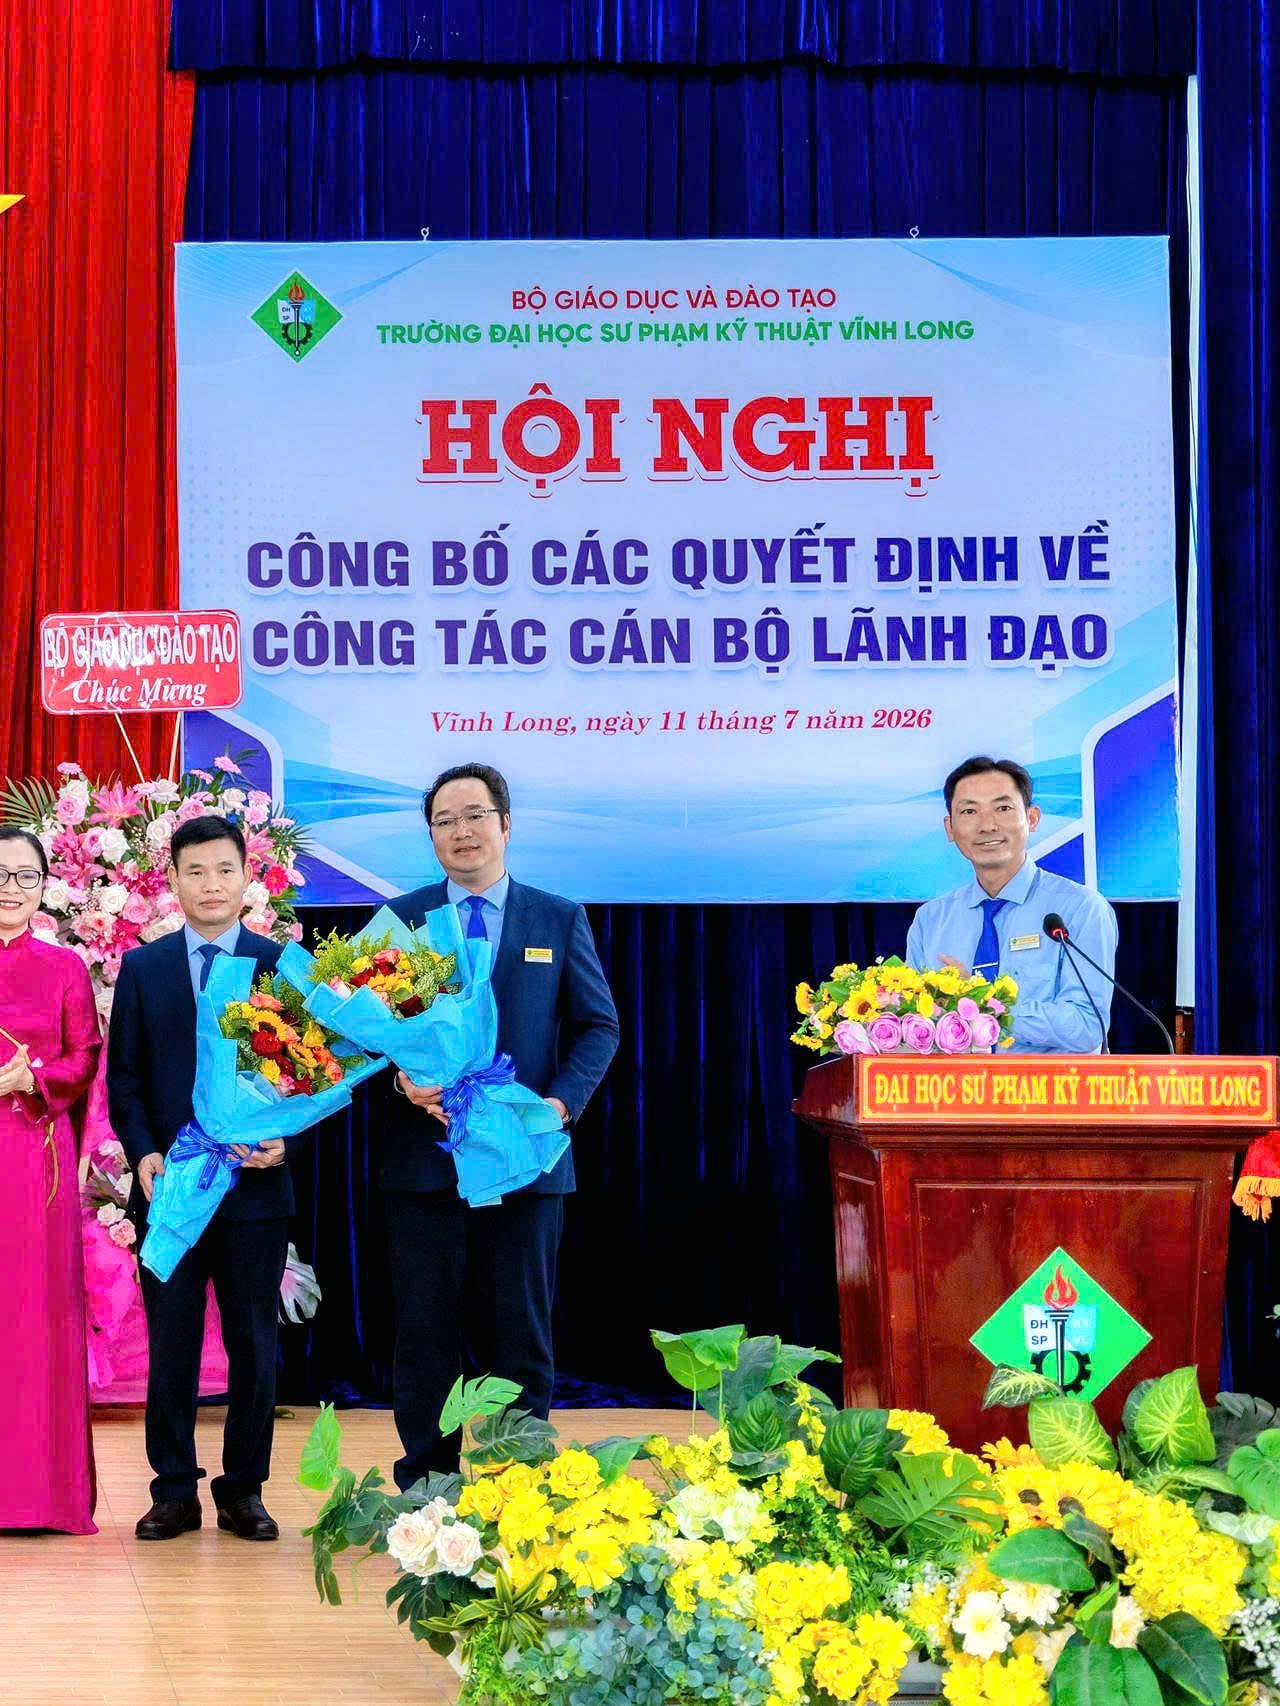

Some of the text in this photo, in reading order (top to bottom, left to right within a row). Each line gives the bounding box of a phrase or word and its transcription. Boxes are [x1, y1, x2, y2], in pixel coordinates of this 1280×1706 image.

[512, 284, 837, 316] BỘ GIÁO DỤC VÀ ĐÀO TẠO
[376, 316, 975, 349] TRƯỜNG ĐẠI HỌC SƯ PHẠM KỸ THUẬT VĨNH LONG
[419, 382, 937, 493] HỘI NGHỊ
[246, 519, 1110, 593] CÔNG BỐ CÁC QUYẾT ĐỊNH VỀ
[44, 622, 69, 677] BỘ
[200, 623, 236, 673] TẠO
[252, 606, 1108, 674] CÔNG TÁC CÁN BỘ LÃNH ĐẠO
[72, 677, 208, 706] Chúc Mừng
[430, 708, 933, 736] Vĩnh Long, ngày 11 tháng 7 năm 2026
[874, 1073, 909, 1112] ĐẠI
[915, 1074, 957, 1112] HỌC
[961, 1070, 988, 1104] SƯ
[992, 1075, 1048, 1112] PHẠM
[1085, 1067, 1152, 1112] THUẬT
[1155, 1068, 1204, 1105] VĨNH
[1209, 1076, 1261, 1107] LONG
[1030, 1319, 1048, 1329] ĐH
[1031, 1335, 1048, 1345] SP
